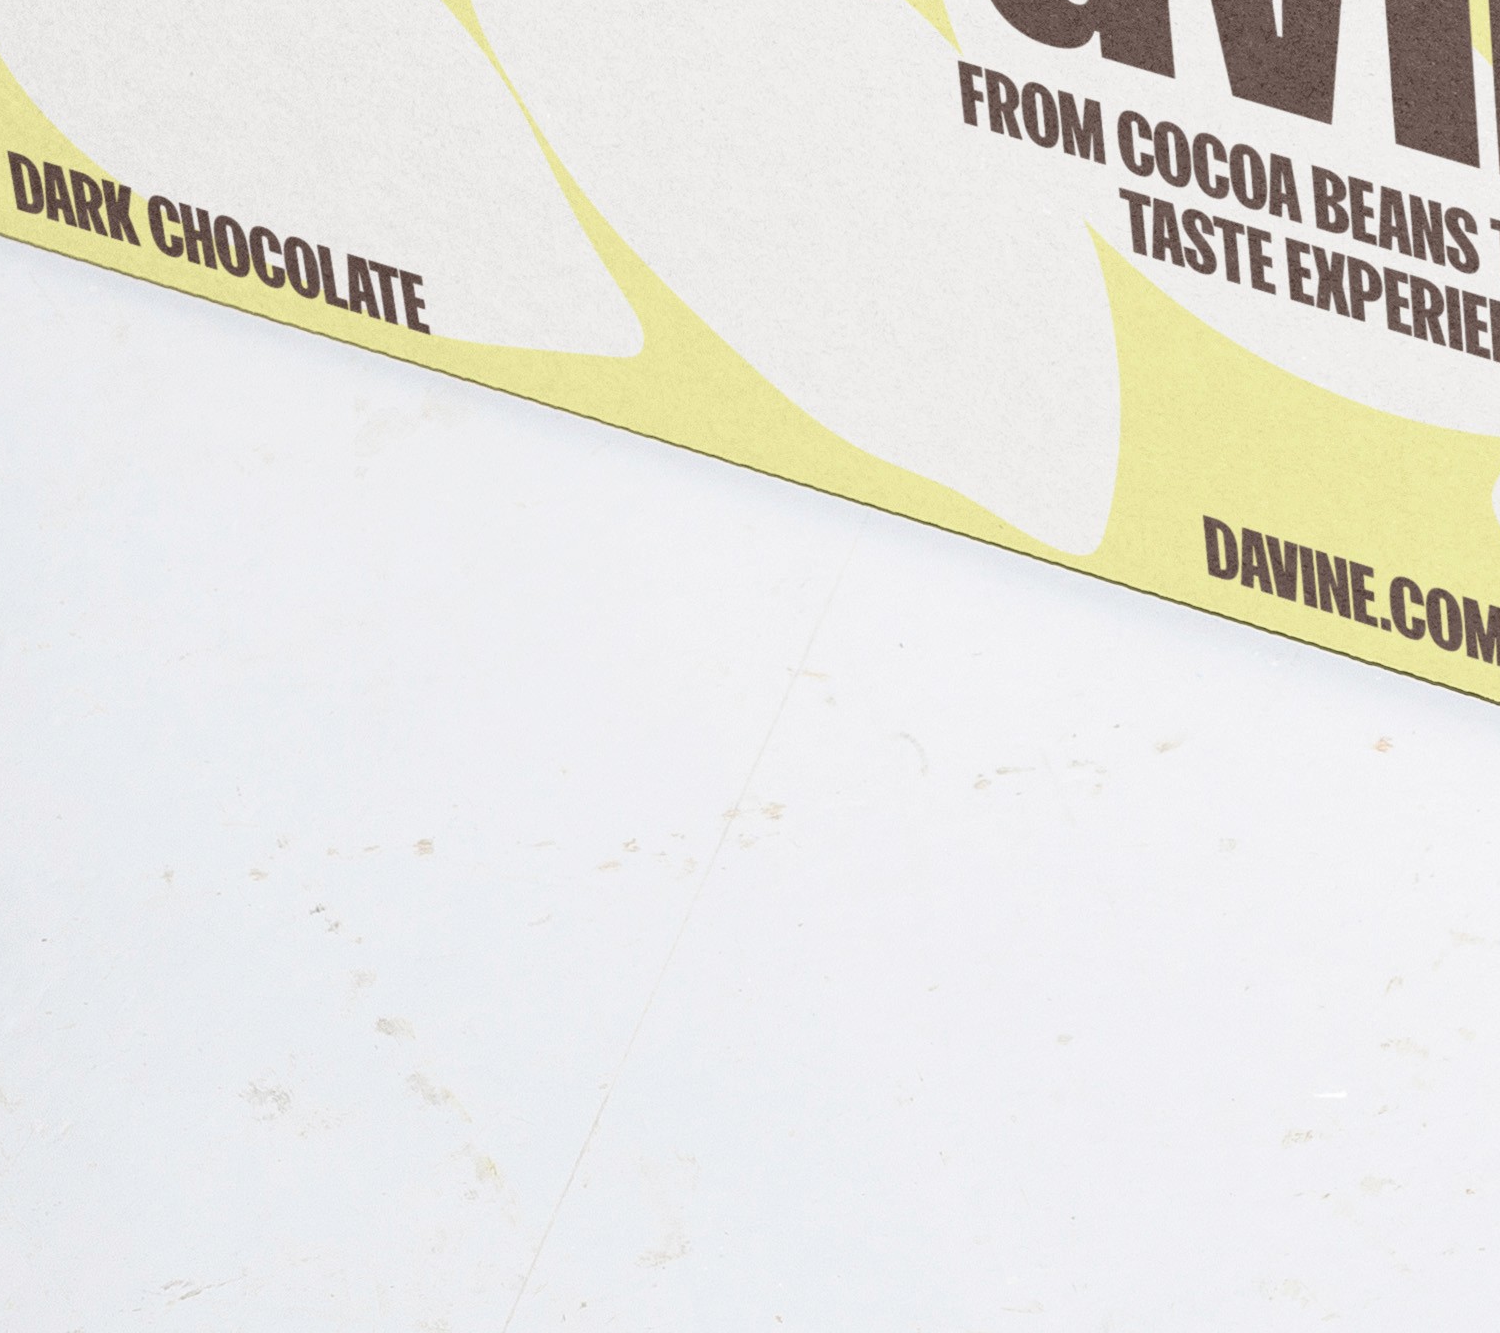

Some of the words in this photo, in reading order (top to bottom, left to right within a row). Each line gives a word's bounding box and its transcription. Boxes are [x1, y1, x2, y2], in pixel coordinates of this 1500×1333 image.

[8, 151, 140, 246] DARK
[148, 195, 430, 335] CHOCOLATE
[958, 61, 1106, 164] FROM
[1118, 111, 1302, 223] COCOA
[1312, 166, 1479, 274] BEANS
[1119, 188, 1276, 294] TASTE
